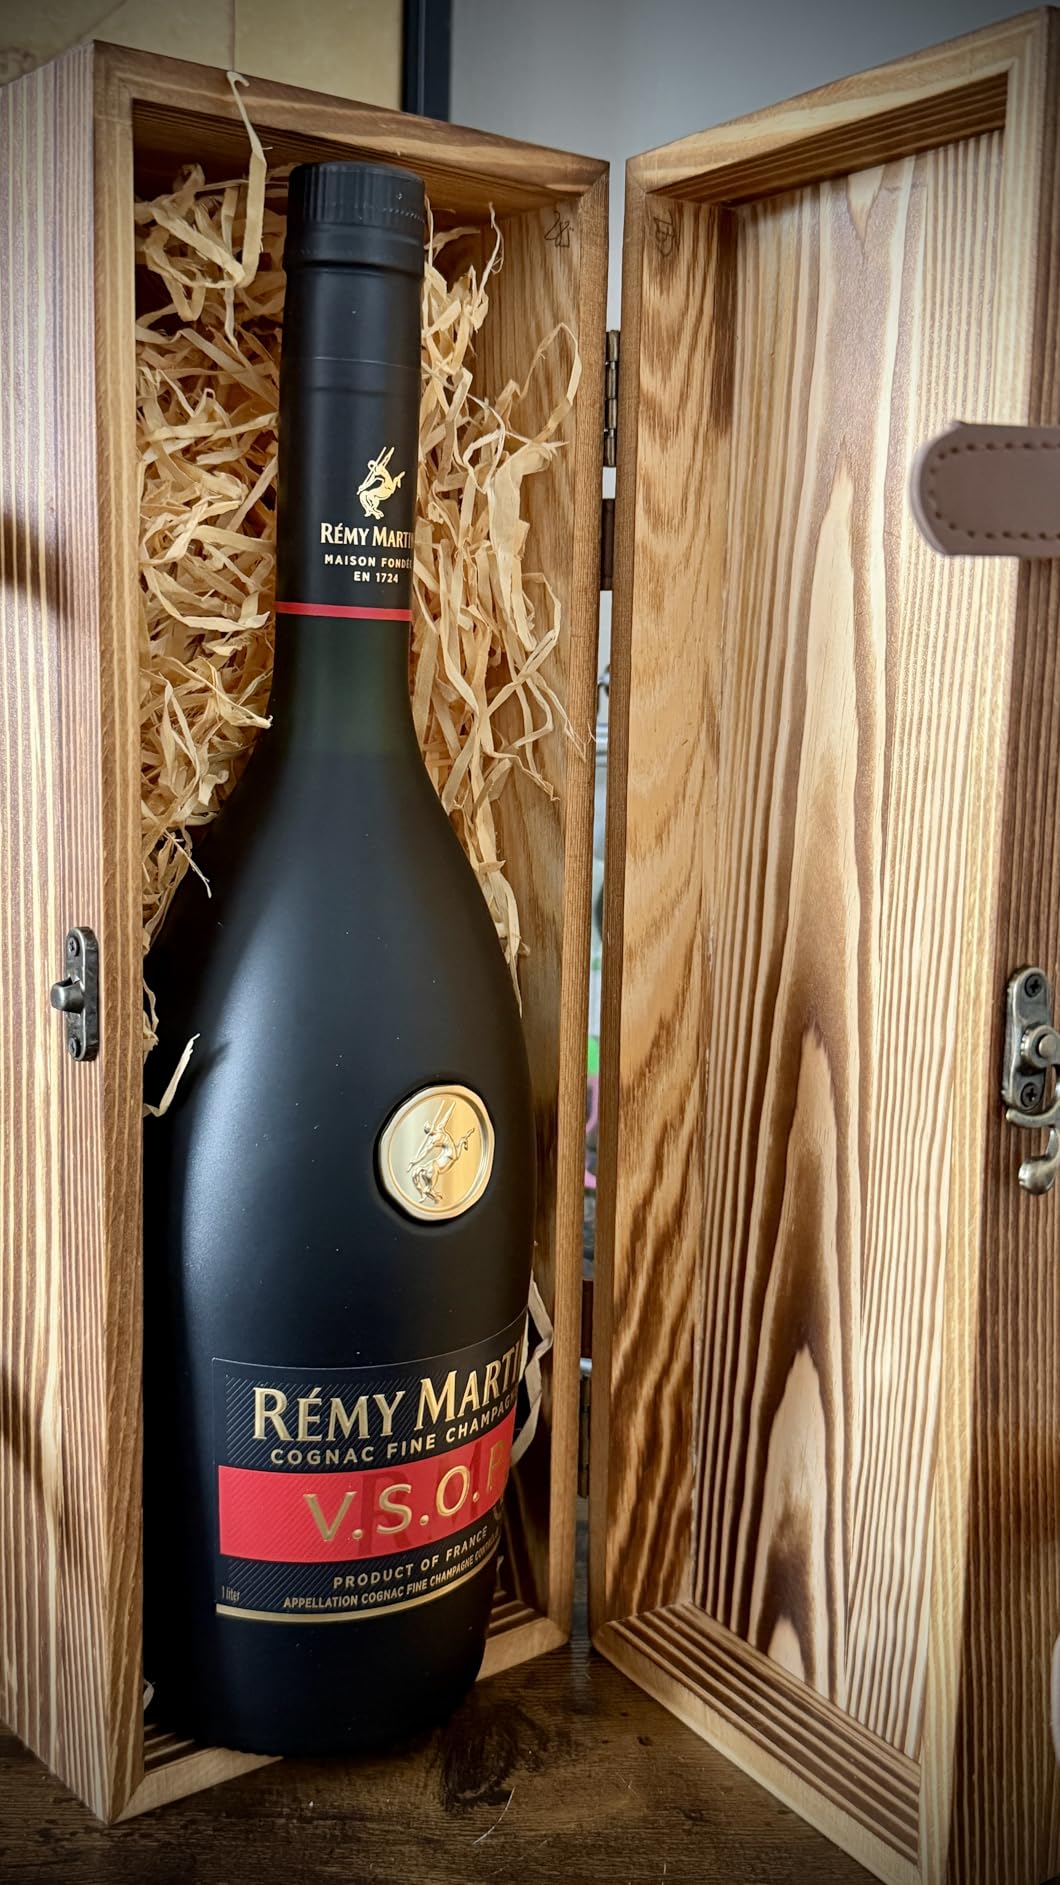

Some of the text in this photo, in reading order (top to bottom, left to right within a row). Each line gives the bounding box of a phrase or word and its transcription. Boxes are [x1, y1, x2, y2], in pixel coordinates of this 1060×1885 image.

[320, 522, 370, 546] RÉMY
[324, 553, 376, 568] MAISON
[353, 570, 399, 584] EN 1724
[251, 1386, 406, 1442] RÉMY
[270, 1391, 514, 1465] COGNAC FINE CHAMPAG
[283, 1593, 359, 1609] APPELLATION
[361, 1586, 405, 1604] COGNAC
[406, 1578, 428, 1596] FINE
[429, 1554, 475, 1588] CHAMPAGNE
[332, 1525, 488, 1590] PRODUCT OF FRANCE
